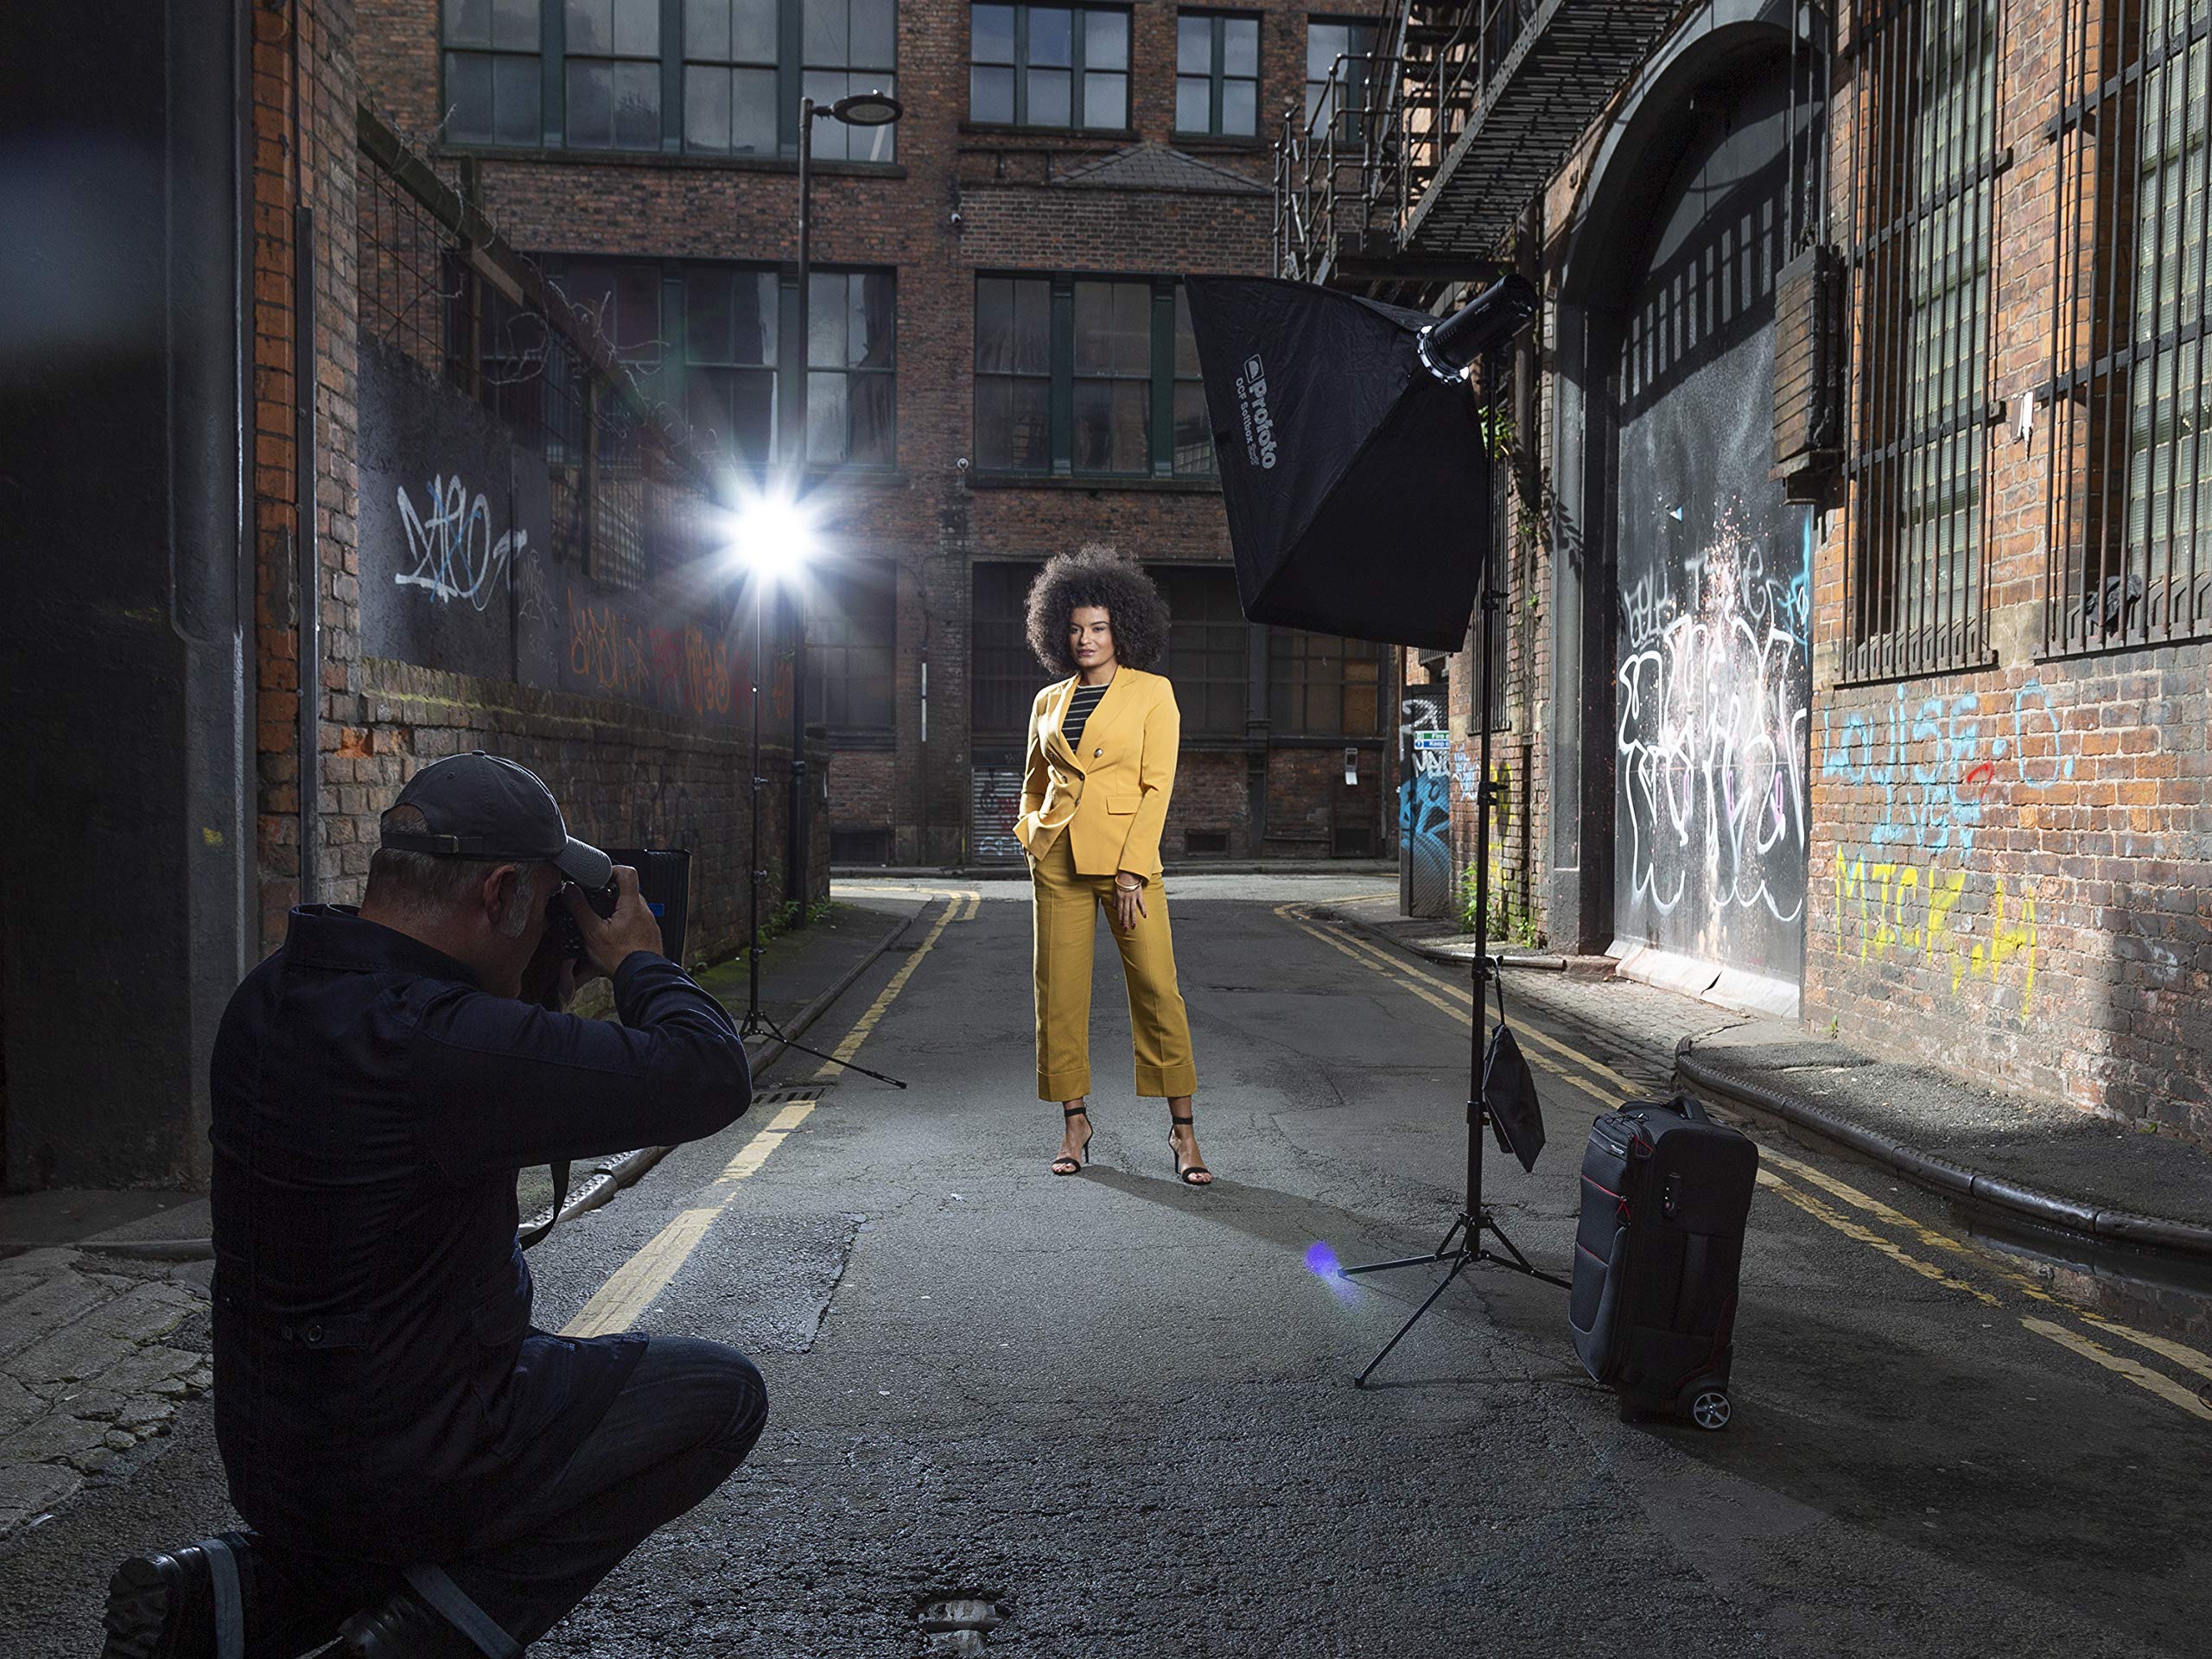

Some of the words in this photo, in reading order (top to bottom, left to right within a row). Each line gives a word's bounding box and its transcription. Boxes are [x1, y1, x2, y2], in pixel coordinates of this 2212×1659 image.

[1236, 377, 1247, 399] OCF
[1241, 401, 1253, 444] Softbox
[1249, 378, 1277, 469] Profoto
